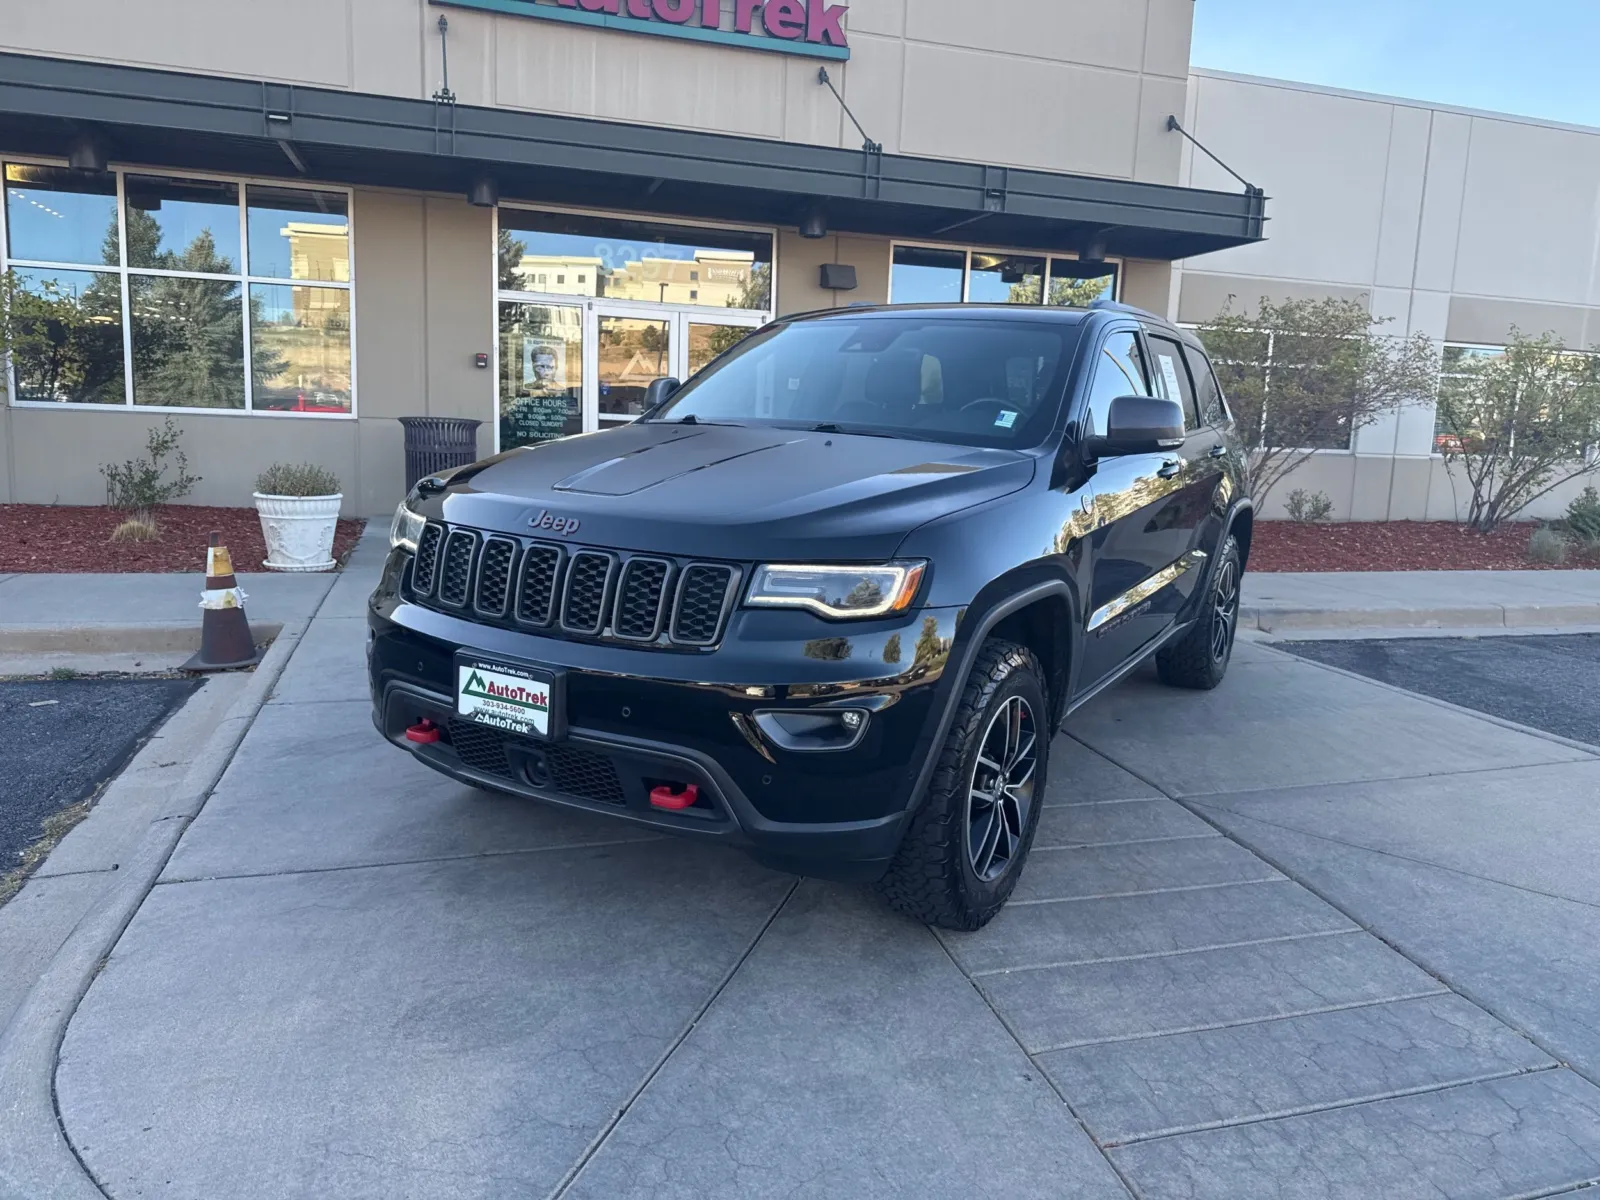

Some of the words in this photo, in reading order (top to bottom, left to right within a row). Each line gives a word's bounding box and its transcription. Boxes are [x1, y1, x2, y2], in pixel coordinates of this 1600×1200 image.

[557, 0, 849, 47] orek
[515, 397, 540, 406] OFFICE
[542, 398, 567, 408] HOURS
[518, 419, 540, 427] CLOSED
[541, 420, 564, 428] SUNDAYS
[528, 509, 580, 536] Jeep
[478, 662, 529, 677] www.AutoTrek.com
[487, 681, 548, 706] AutoTrek
[482, 699, 526, 714] 303-934-5600
[483, 713, 529, 734] AutoTrek
